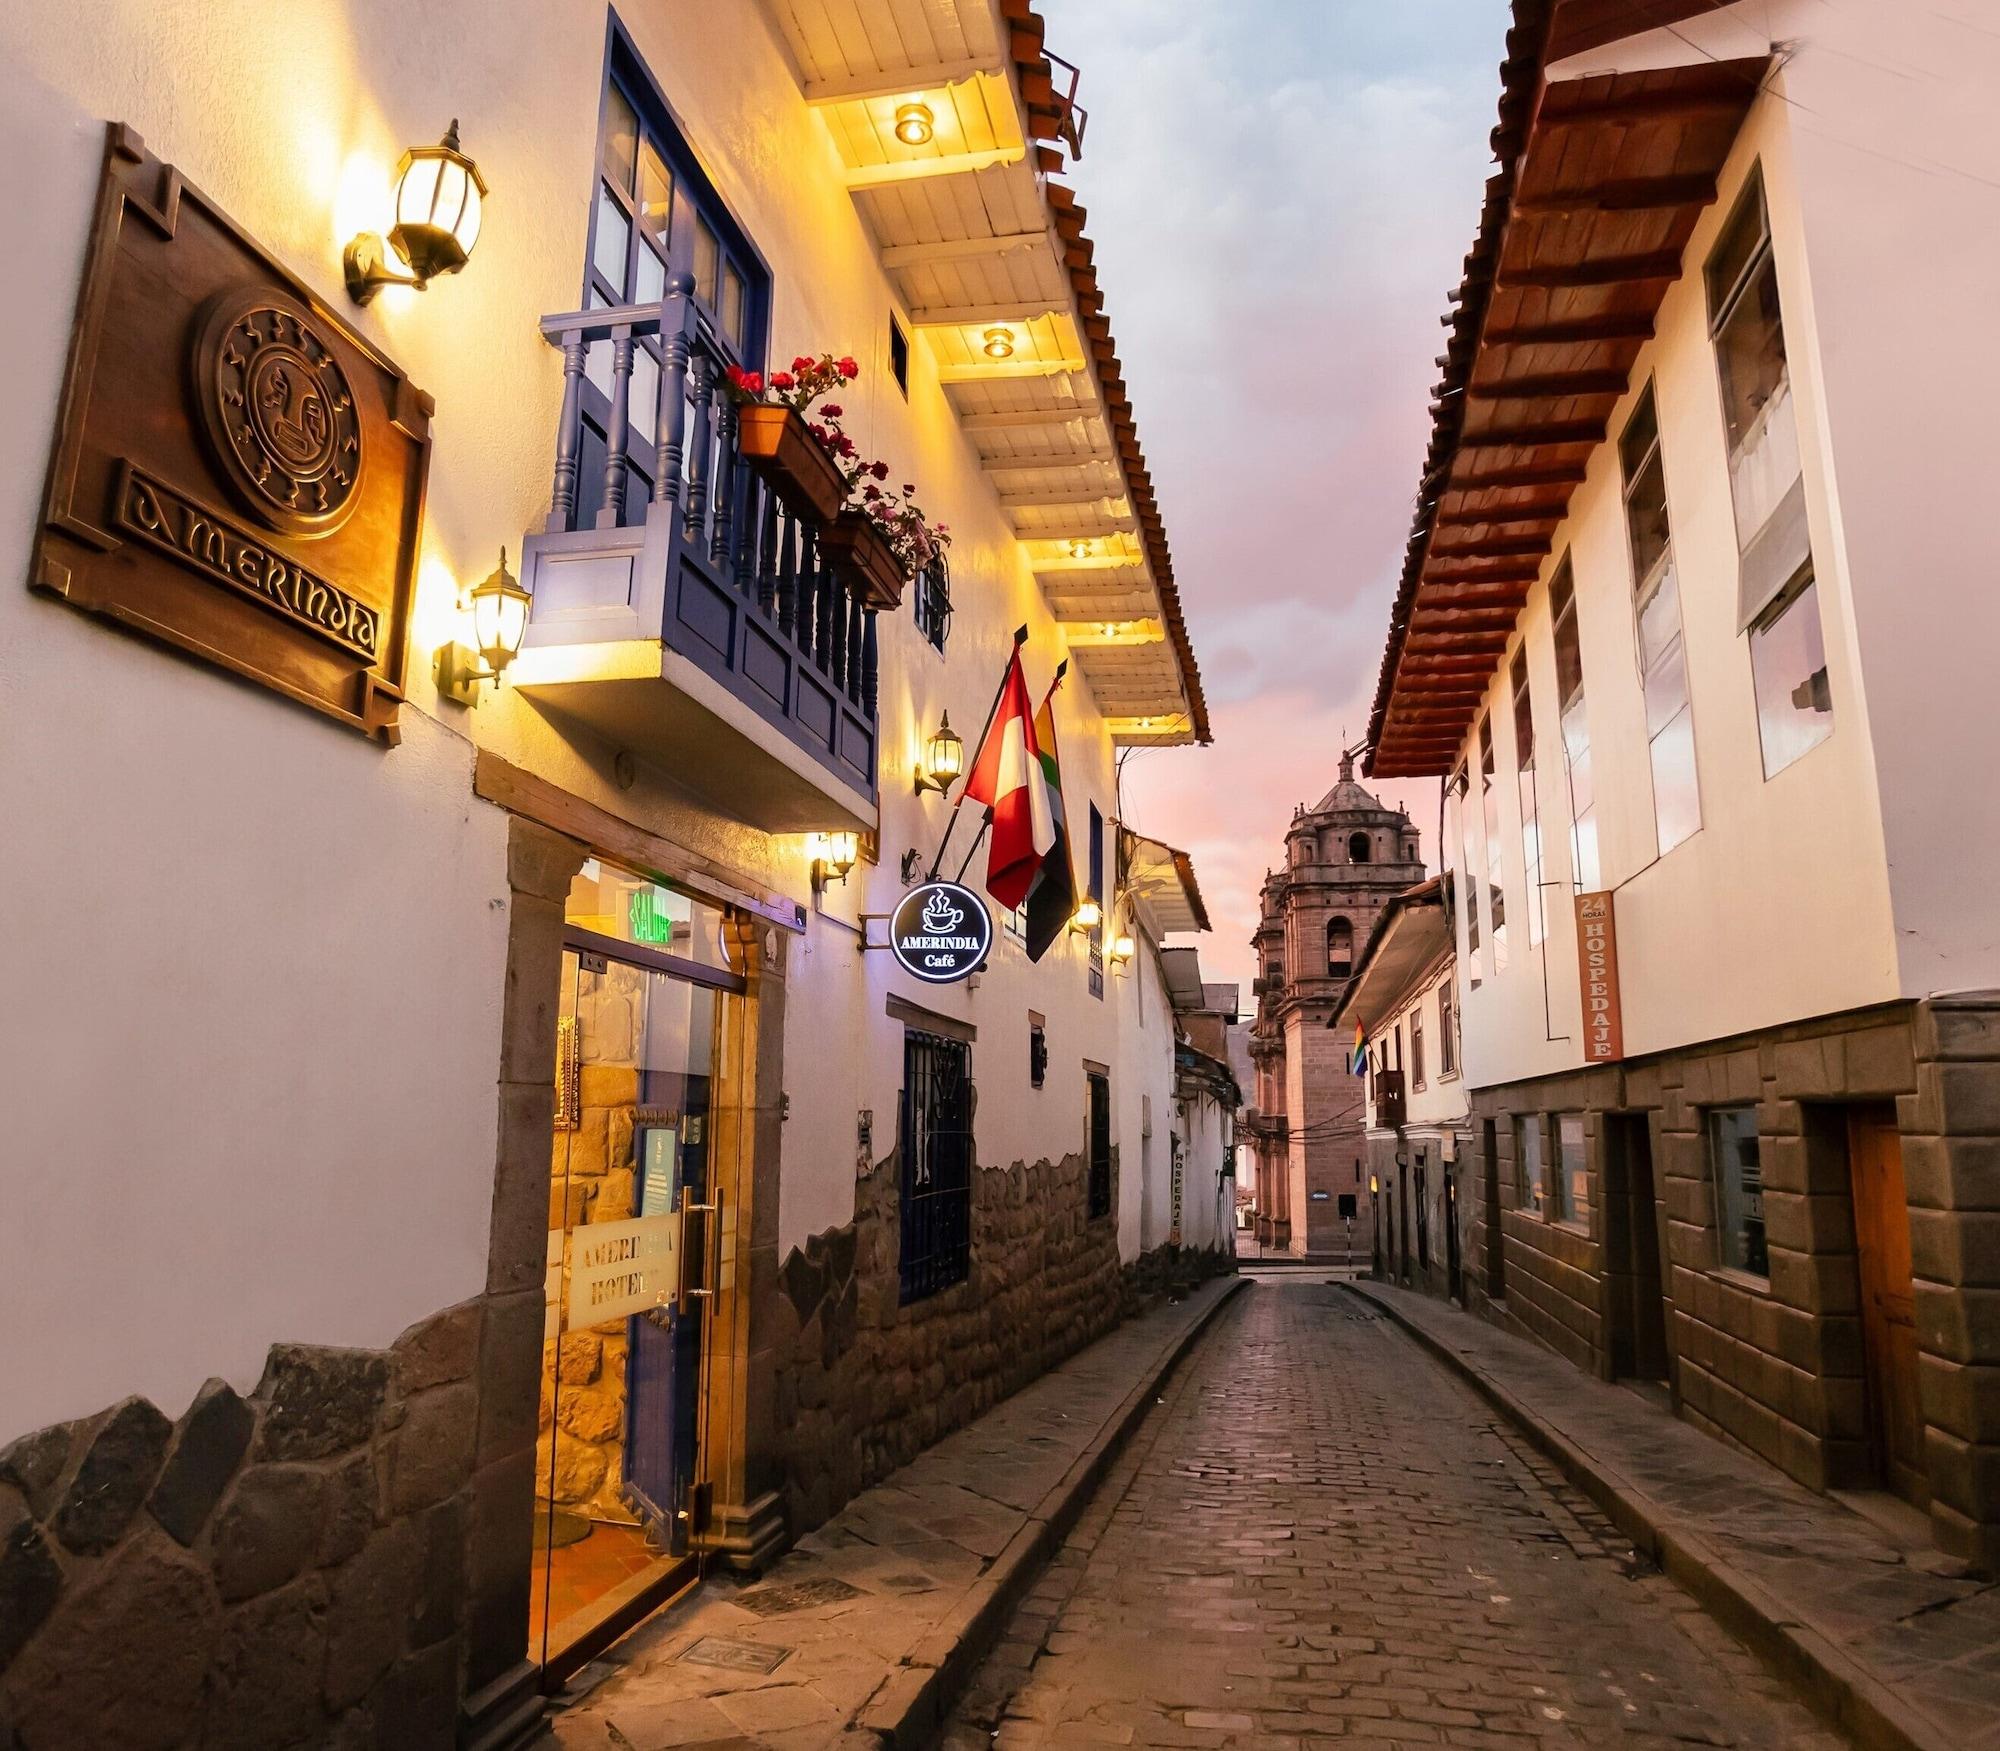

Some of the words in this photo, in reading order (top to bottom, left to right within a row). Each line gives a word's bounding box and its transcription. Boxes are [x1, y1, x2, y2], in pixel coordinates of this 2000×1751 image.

[1581, 897, 1606, 911] 24
[1582, 910, 1606, 919] HORAS
[900, 936, 979, 950] AMERINDIA
[924, 954, 956, 967] Café
[1584, 923, 1611, 1056] HOSPEDAJE
[1173, 1154, 1183, 1227] HOSPEDAJE
[591, 1272, 648, 1306] HOTEL
